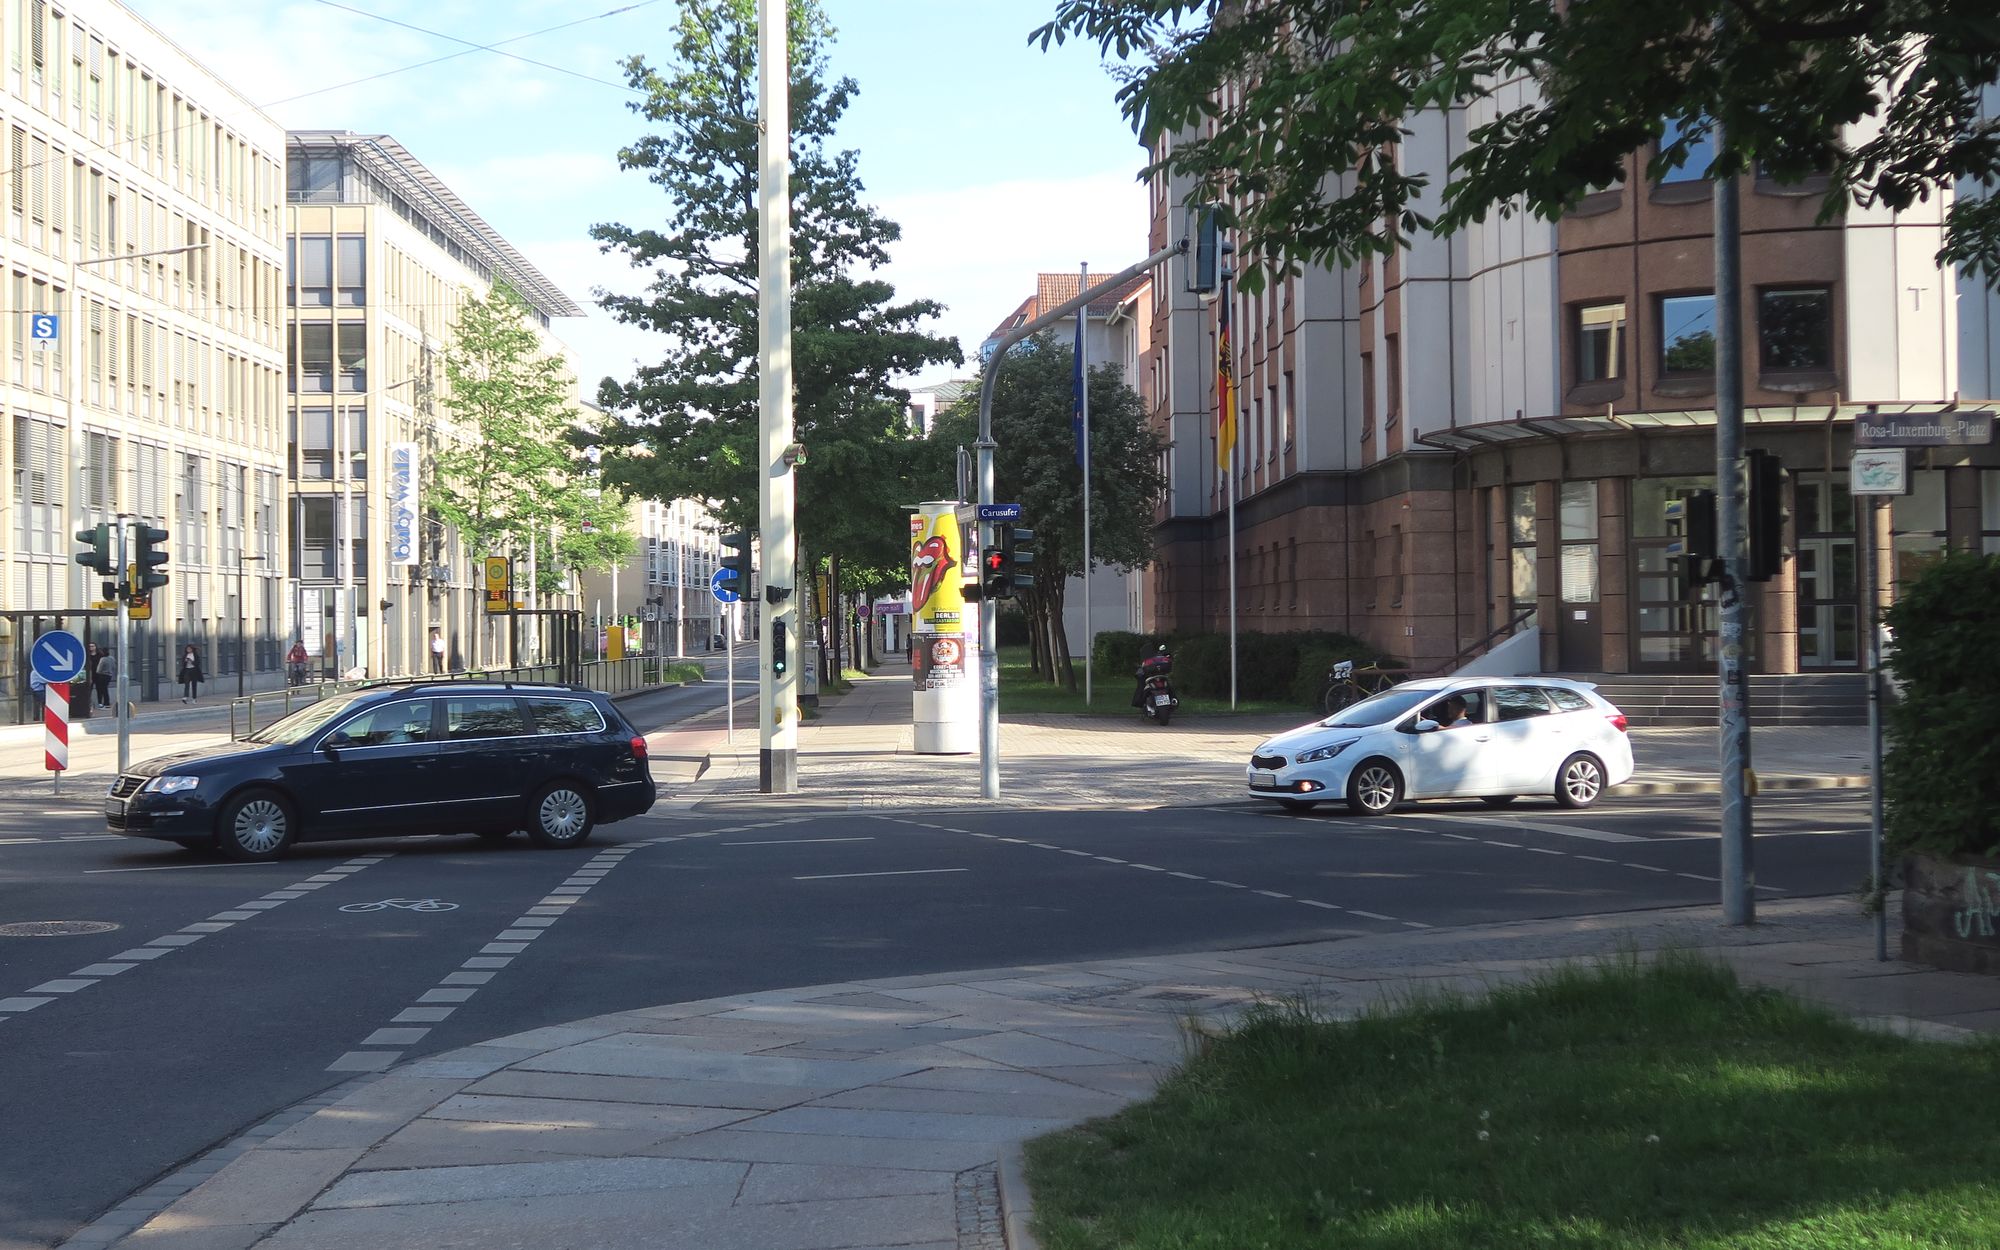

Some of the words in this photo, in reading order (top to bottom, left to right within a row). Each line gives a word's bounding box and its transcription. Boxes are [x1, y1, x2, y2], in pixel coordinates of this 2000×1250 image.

[36, 318, 53, 338] S
[1861, 420, 1987, 439] Rosa-Luxemburg-Platz
[981, 508, 1018, 517] Carusufer
